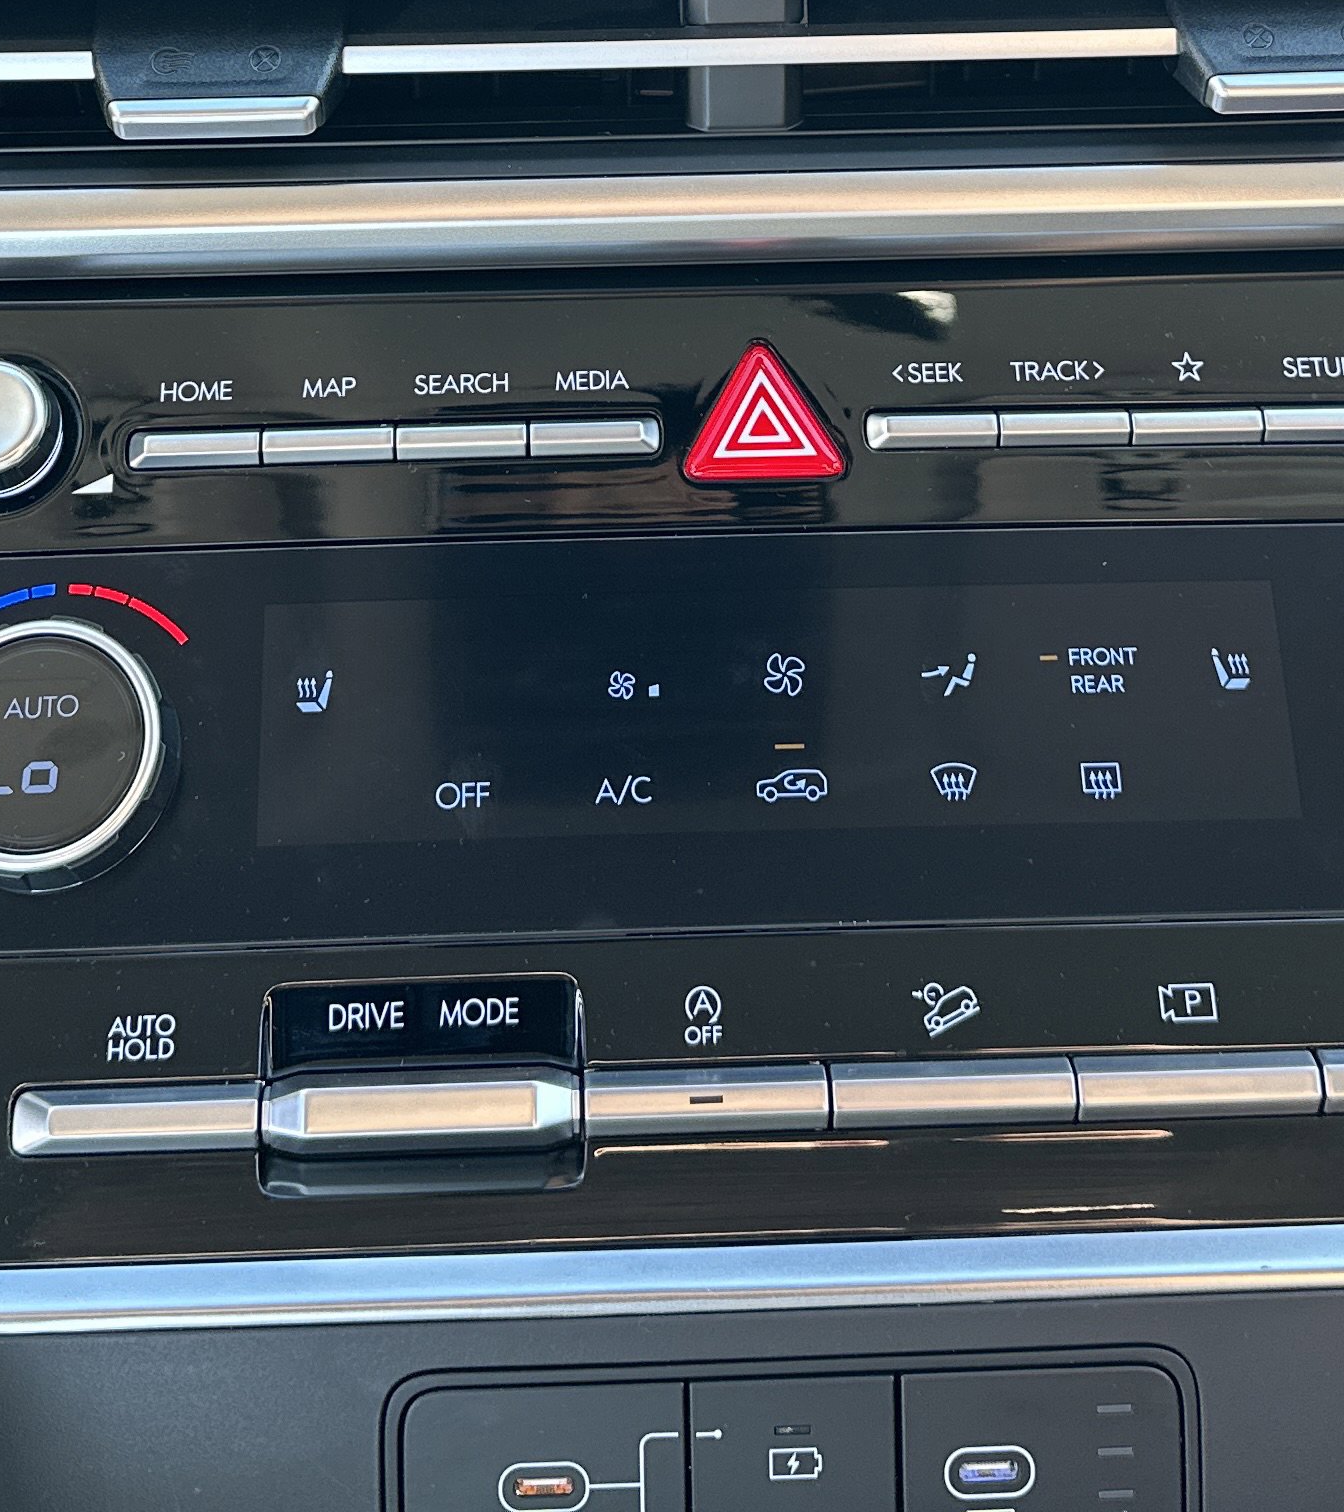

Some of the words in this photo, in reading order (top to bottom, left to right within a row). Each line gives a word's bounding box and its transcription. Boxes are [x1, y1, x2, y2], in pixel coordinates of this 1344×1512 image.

[159, 380, 233, 403] HOME
[302, 376, 357, 398] MAP
[413, 372, 509, 395] SEARCH
[555, 369, 630, 391] MEDIA
[1067, 646, 1138, 666] FRONT
[1070, 674, 1126, 694] REAR
[3, 694, 79, 720] AUTO
[435, 781, 491, 810] OFF
[595, 774, 653, 806] A/C
[107, 1013, 176, 1038] AUTO
[328, 1000, 405, 1032] DRIVE
[439, 996, 520, 1028] MODE
[684, 1025, 723, 1046] OFF
[106, 1037, 175, 1062] HOLD
